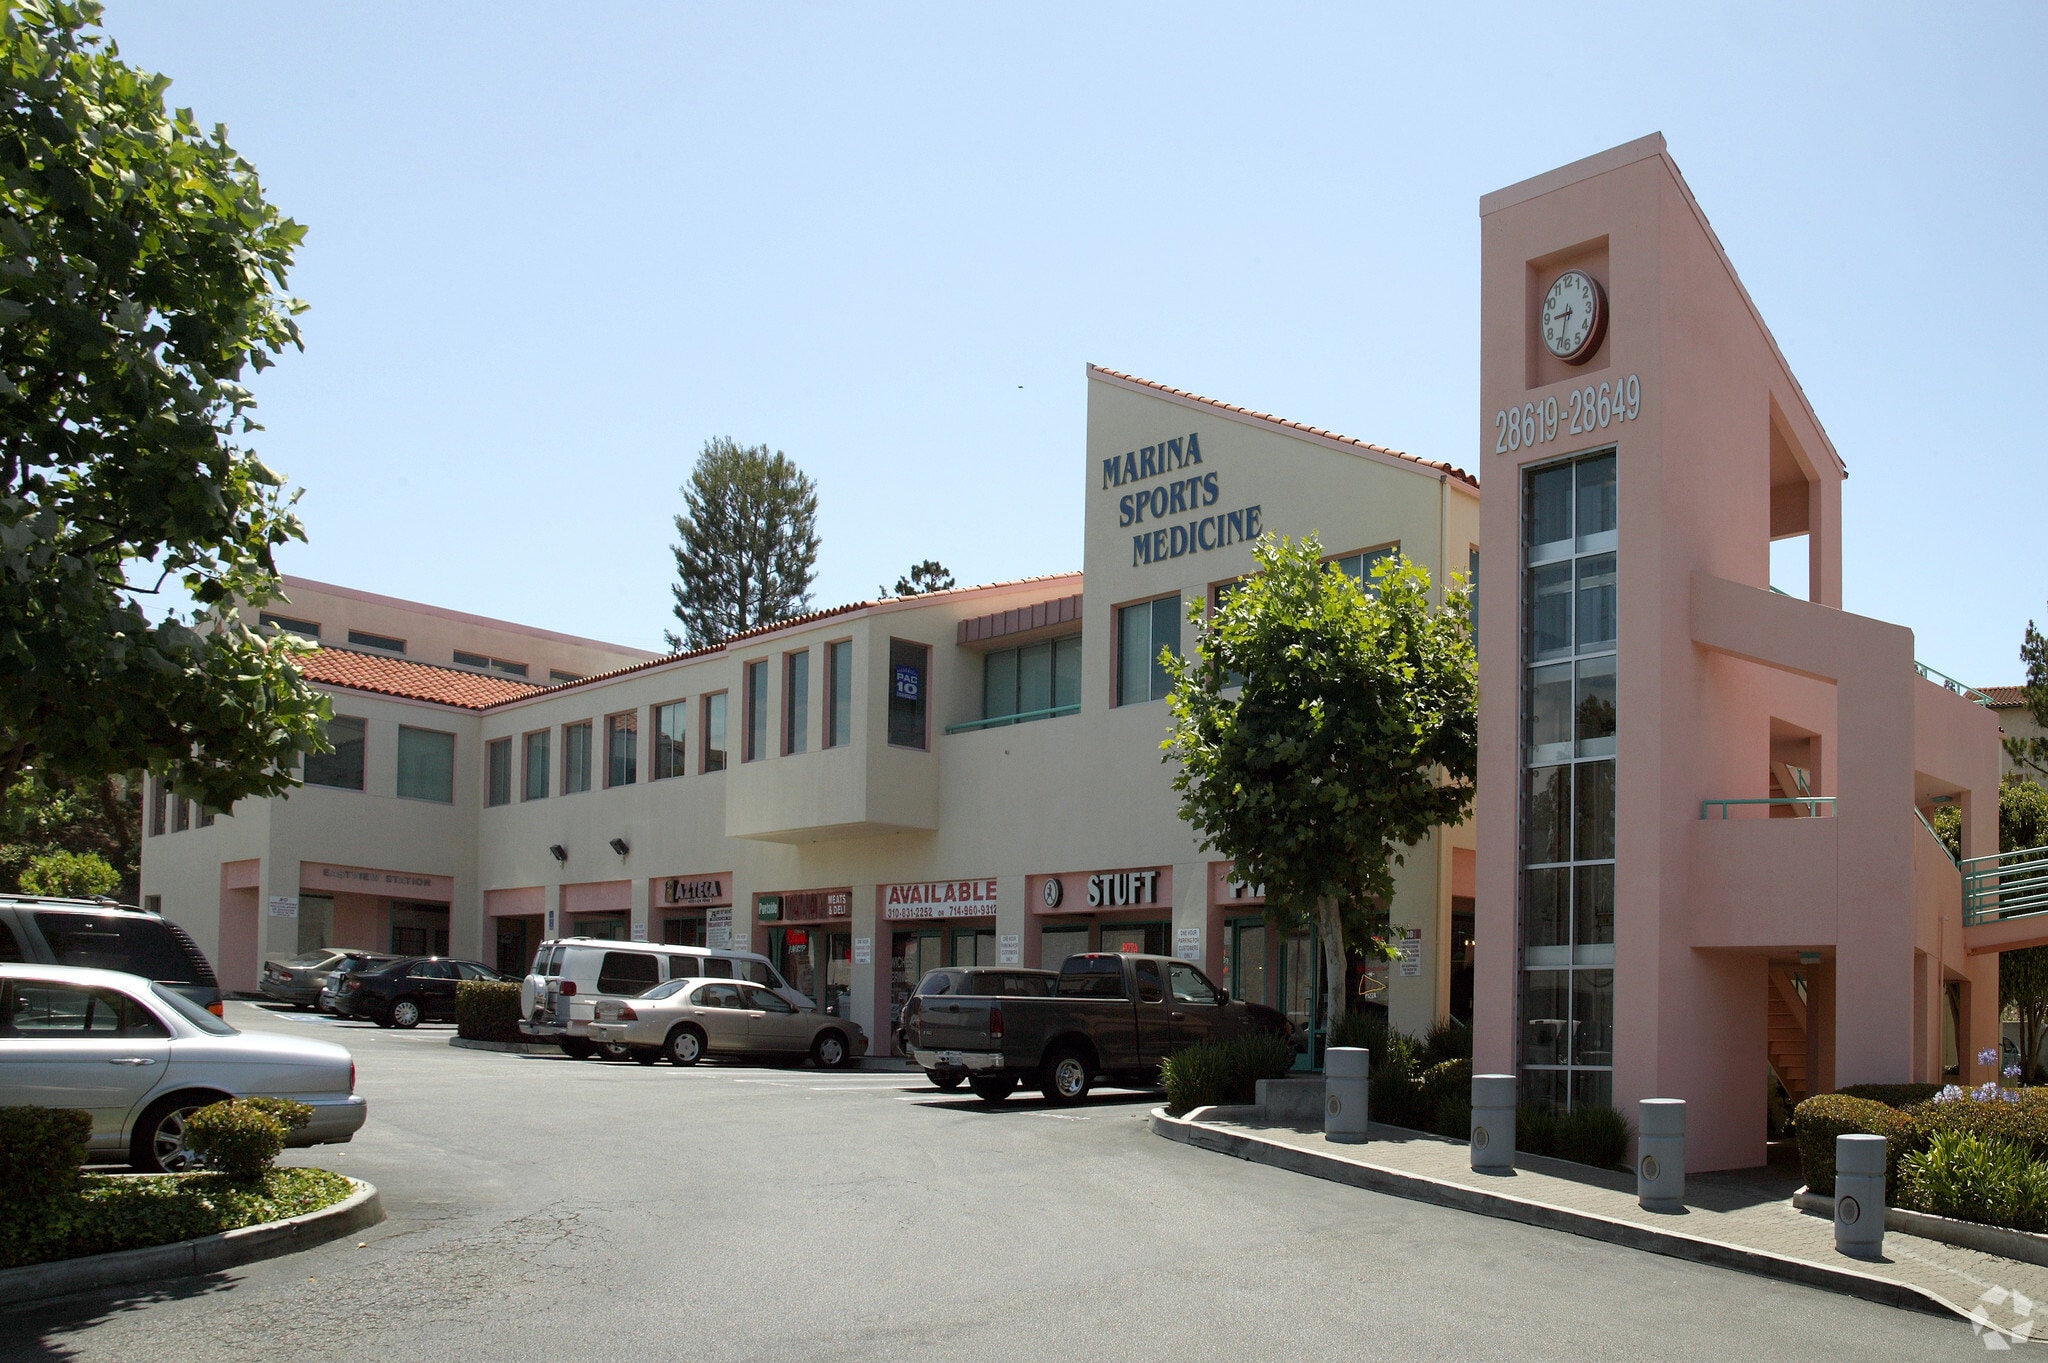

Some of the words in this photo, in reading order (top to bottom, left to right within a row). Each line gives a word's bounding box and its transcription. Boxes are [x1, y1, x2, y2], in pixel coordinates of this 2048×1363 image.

[1563, 275, 1573, 289] 12
[1575, 278, 1581, 290] 1
[1553, 283, 1562, 297] 11
[1582, 286, 1589, 298] 2
[1545, 297, 1556, 310] 10
[1585, 302, 1592, 314] 3
[1543, 313, 1551, 326] 9
[1581, 318, 1589, 331] 4
[1547, 328, 1554, 341] 8
[1574, 332, 1581, 345] 5
[1556, 337, 1562, 350] 7
[1563, 339, 1571, 351] 6
[1495, 373, 1641, 455] 28619-28649
[1102, 432, 1203, 490] MARINA
[1119, 471, 1220, 528] SPORTS
[1132, 505, 1263, 567] MEDICINE
[896, 672, 918, 684] PAC
[897, 682, 918, 695] 10
[323, 868, 378, 882] EASTVIEW
[385, 875, 431, 887] STATION
[675, 880, 721, 900] AZTECA
[889, 882, 997, 904] AVAILABLE
[1087, 871, 1157, 907] STUFT
[827, 894, 846, 905] MEATS
[759, 902, 778, 915] Portside
[834, 905, 846, 914] DELI
